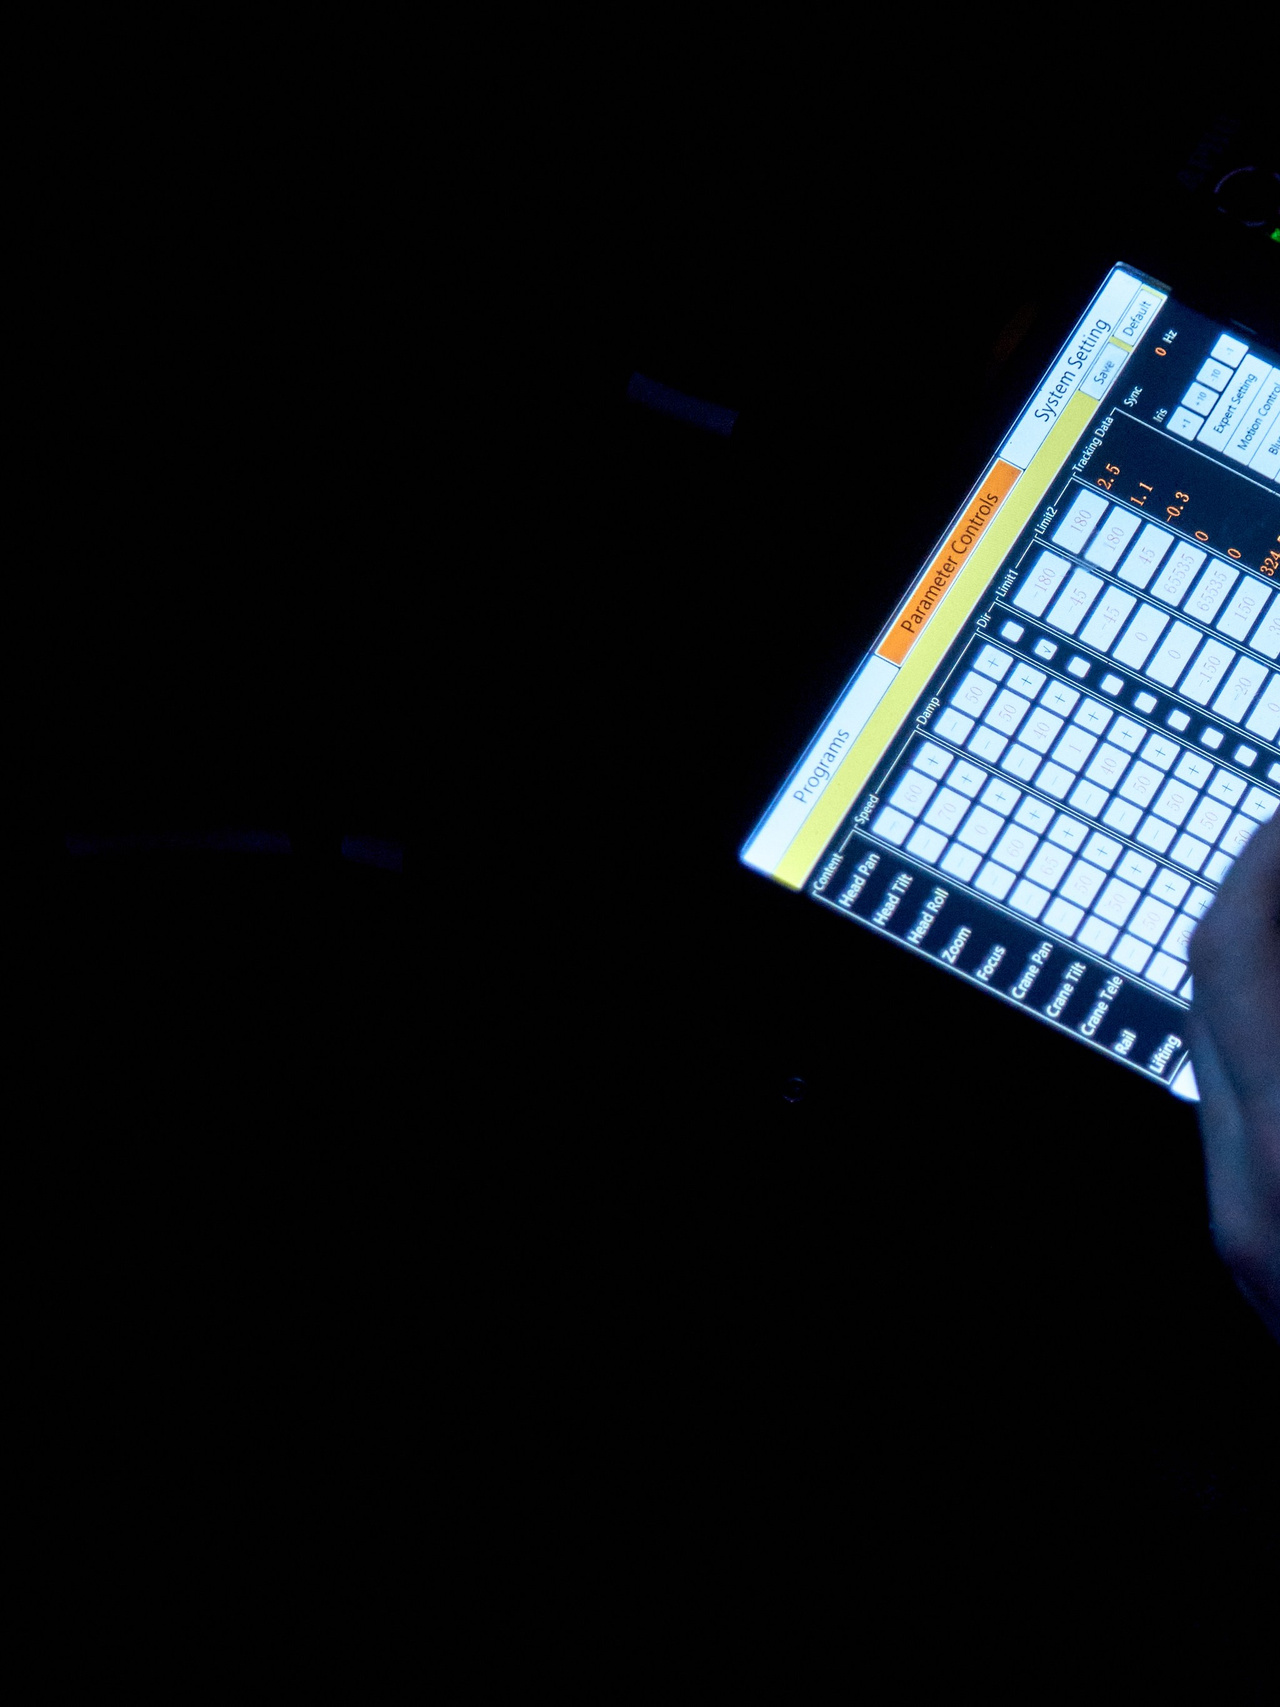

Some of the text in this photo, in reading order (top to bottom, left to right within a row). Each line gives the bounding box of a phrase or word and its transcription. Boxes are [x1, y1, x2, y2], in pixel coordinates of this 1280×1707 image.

[1121, 300, 1151, 337] Default
[1033, 318, 1112, 423] System Setting
[1092, 360, 1115, 386] Save
[1122, 329, 1178, 408] Sync 0 Hz
[1152, 407, 1168, 423] Iris
[1212, 373, 1258, 434] Expert Setting
[1070, 416, 1114, 473] Tracking Data
[1236, 417, 1261, 451] Motion
[1096, 462, 1121, 491] 2.5
[1129, 481, 1153, 506] 1.1
[1165, 490, 1190, 522] -0.3
[1033, 505, 1058, 535] Limit2
[1069, 506, 1093, 534] 180
[1102, 525, 1126, 552] 180
[1194, 529, 1209, 542] 0
[899, 492, 999, 634] Parameter Controls
[1136, 545, 1157, 567] 45
[1226, 547, 1242, 559] 0
[994, 568, 1019, 598] Limit1
[1033, 565, 1057, 599] -180
[1162, 552, 1196, 596] 65535
[1068, 587, 1089, 613] -45
[1194, 569, 1228, 613] 65535
[975, 611, 992, 628] Dir
[1101, 604, 1121, 631] -45
[1232, 594, 1257, 622] 150
[1133, 630, 1149, 644] 0
[1166, 647, 1183, 661] 0
[1197, 653, 1223, 688] -150
[964, 683, 985, 705] 50
[1233, 675, 1253, 701] -20
[915, 696, 941, 726] Damp
[997, 701, 1018, 723] 50
[1031, 719, 1052, 741] 40
[792, 728, 850, 803] Programs
[1098, 755, 1119, 777] 40
[1131, 773, 1152, 795] 50
[853, 793, 879, 825] Speed
[1165, 791, 1186, 813] 50
[1199, 809, 1220, 831] 50
[812, 852, 843, 891] Content
[838, 853, 880, 907] Head Pan
[872, 873, 913, 926] Head Tilt
[906, 887, 949, 944] Head Roll
[940, 926, 972, 964] Zoom
[975, 945, 1006, 981] Focus
[1011, 941, 1053, 999] Crane Pan
[1045, 961, 1086, 1018] Crane Tilt
[1080, 975, 1123, 1036] Crane Tele
[1113, 1029, 1136, 1055] Rail
[1148, 1034, 1182, 1074] Lifting
